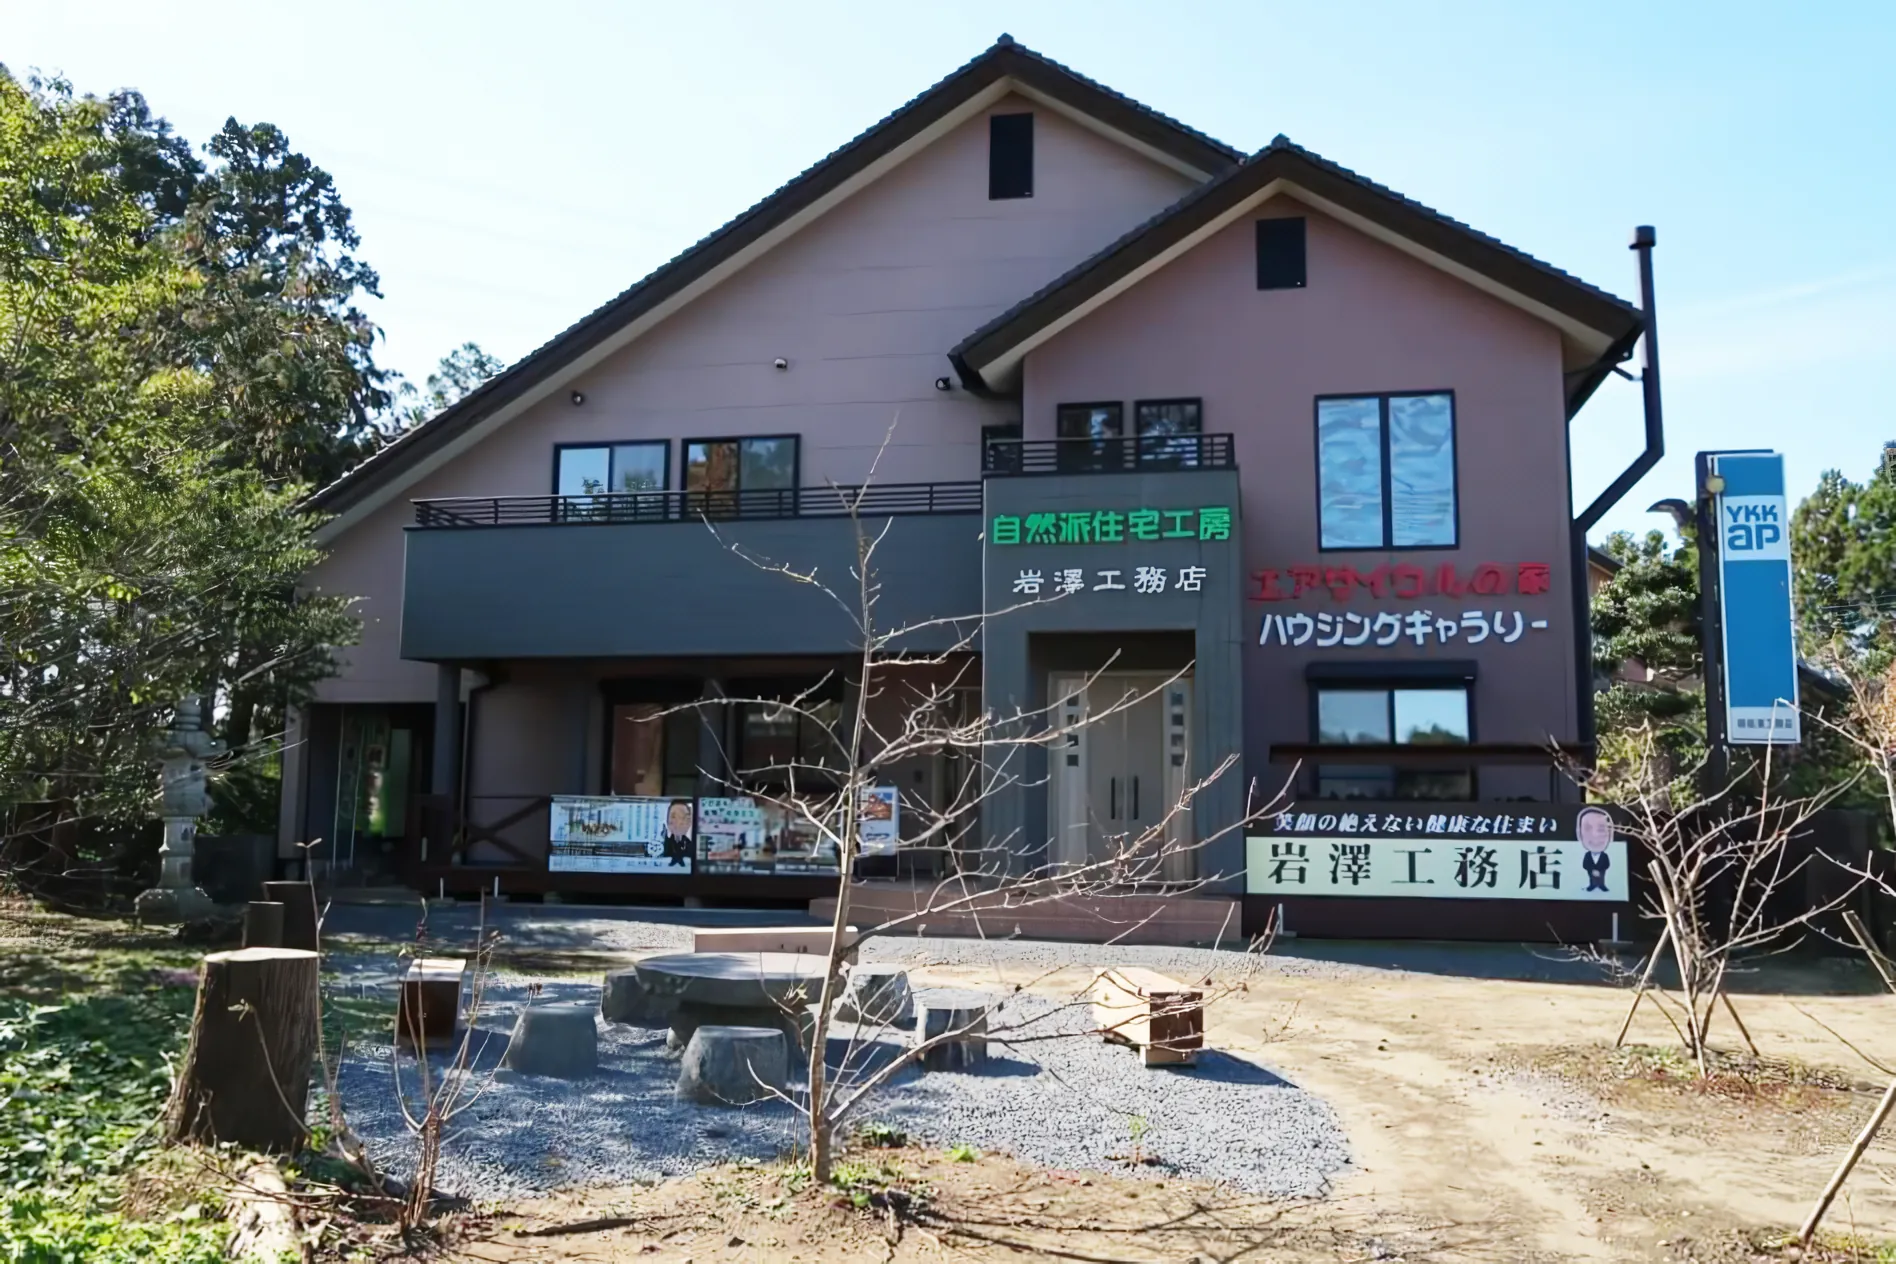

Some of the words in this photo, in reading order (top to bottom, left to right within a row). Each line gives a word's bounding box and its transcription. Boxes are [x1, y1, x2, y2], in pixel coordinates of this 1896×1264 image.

[992, 507, 1231, 544] 自然派住宅工房
[1726, 504, 1778, 523] YKK
[1727, 524, 1780, 550] ap
[1012, 566, 1207, 594] 岩澤工務店
[1259, 609, 1548, 647] ハウジングギャラリー
[1273, 812, 1557, 834] 笑顔の絶えない健康な住まい
[1267, 842, 1563, 890] 岩澤工務店
